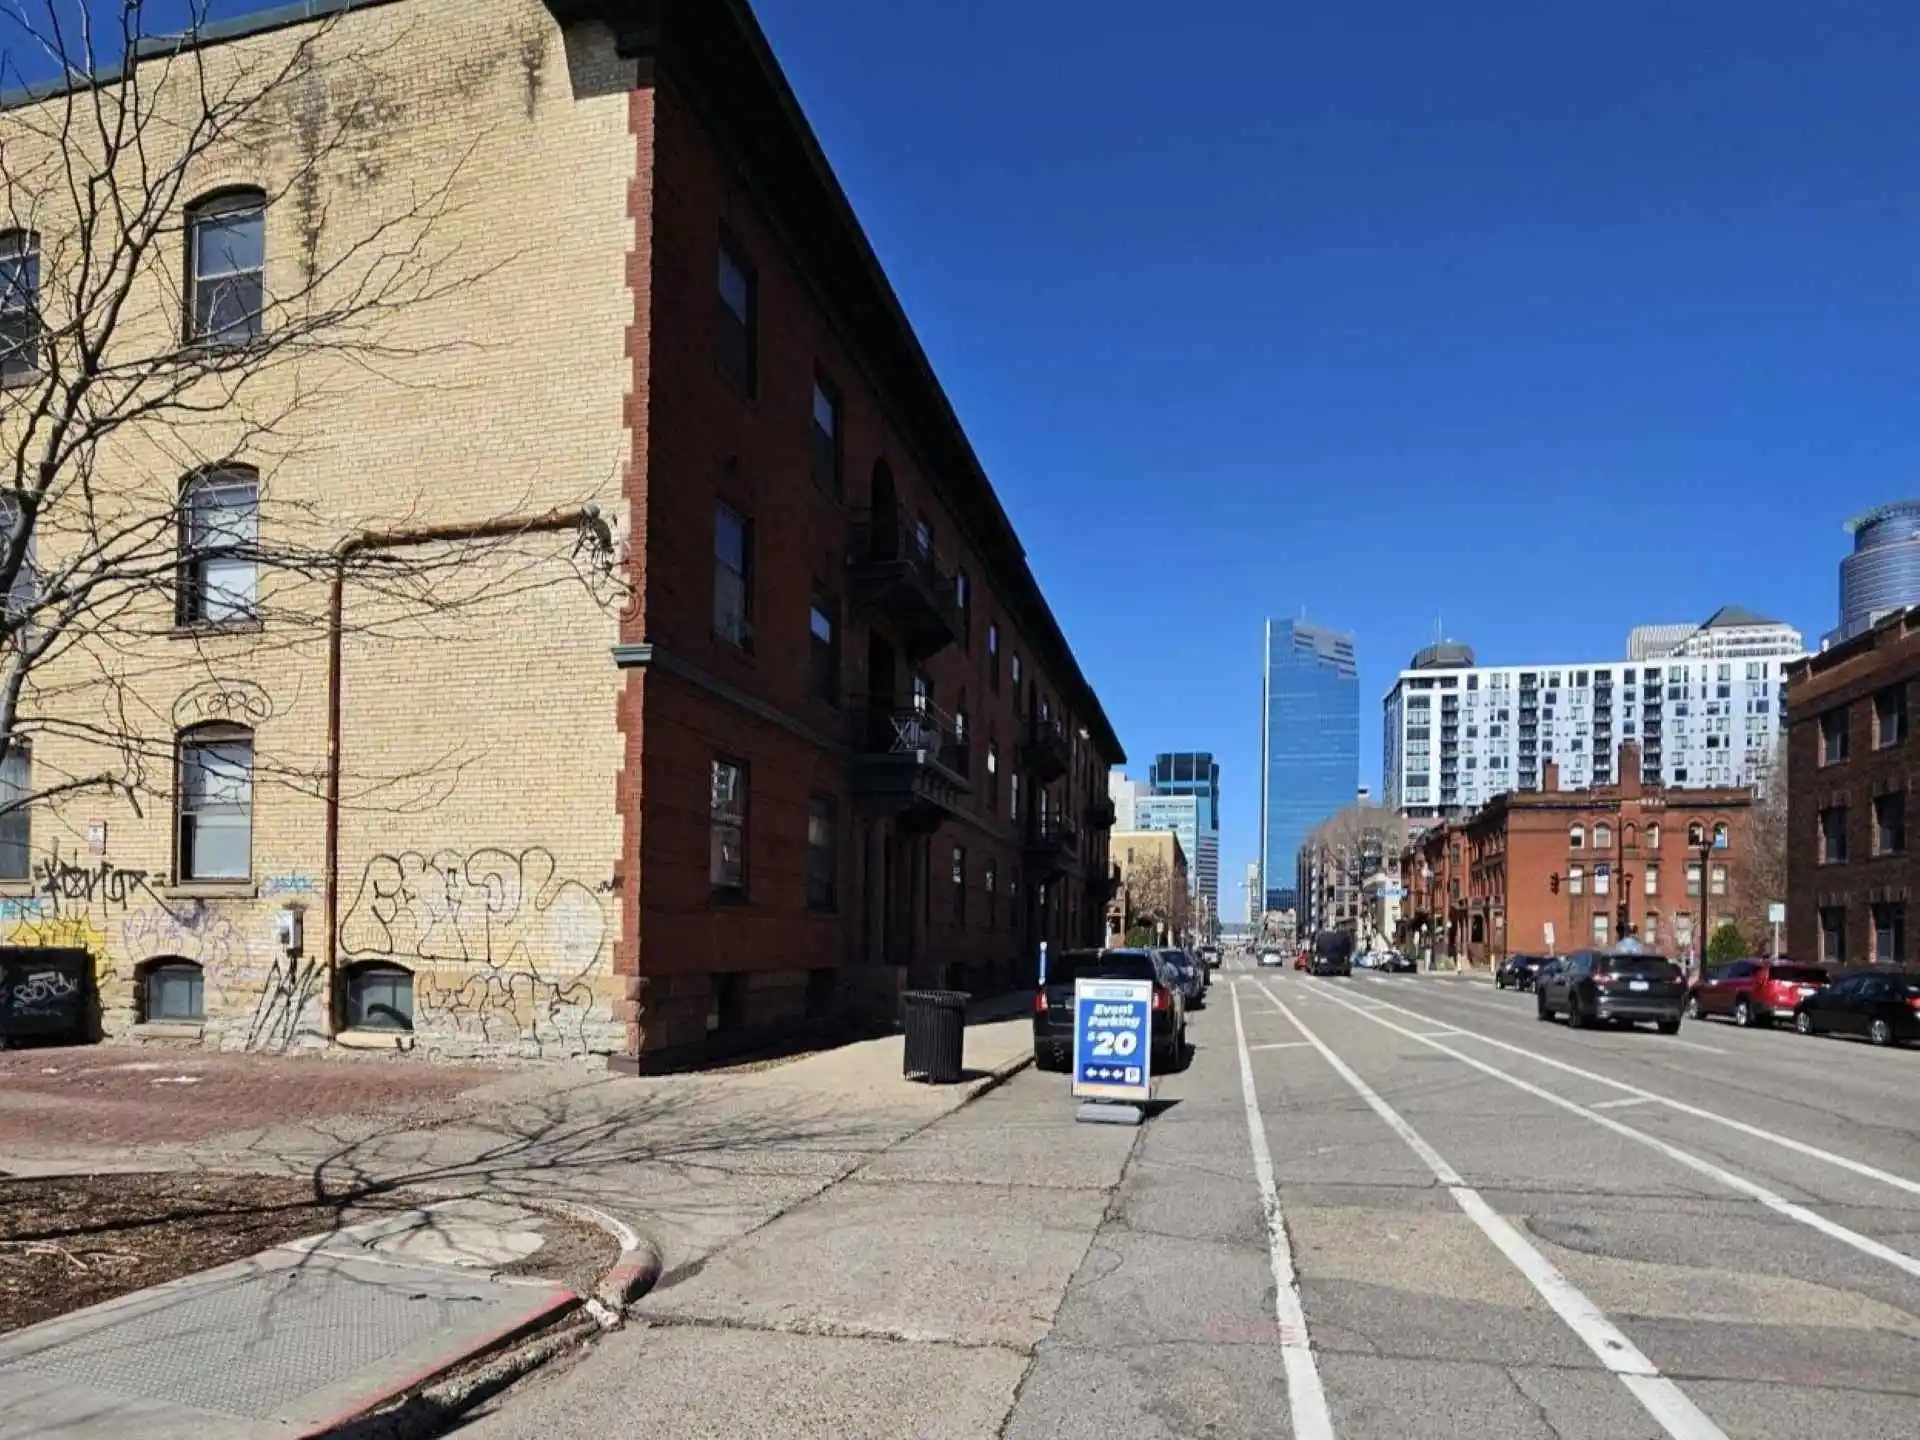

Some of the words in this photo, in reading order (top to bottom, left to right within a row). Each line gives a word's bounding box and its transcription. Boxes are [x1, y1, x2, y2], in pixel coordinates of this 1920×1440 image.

[1093, 1003, 1134, 1016] Event
[1087, 1015, 1141, 1029] Parking
[1086, 1031, 1137, 1056] $20
